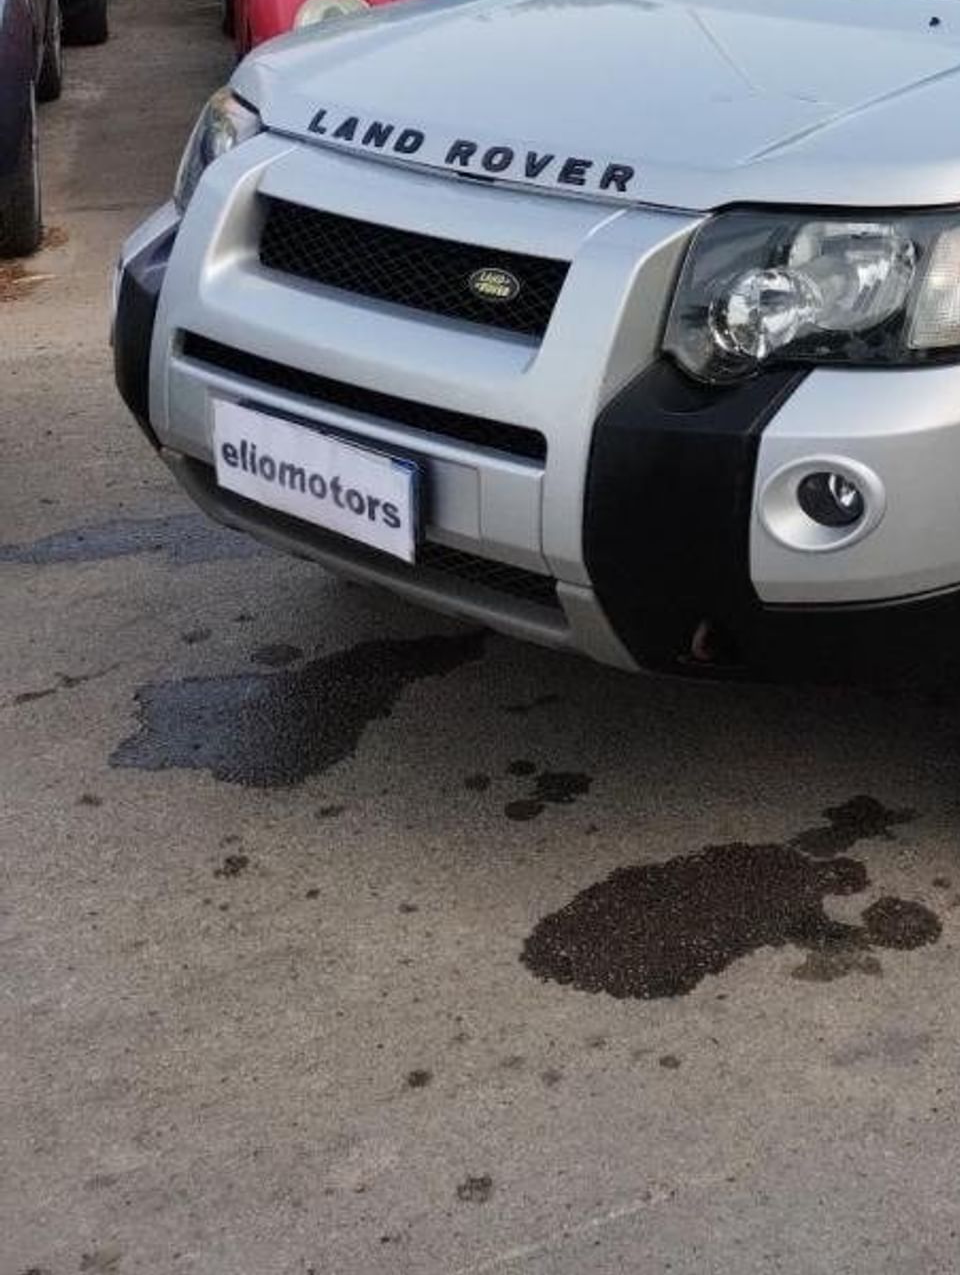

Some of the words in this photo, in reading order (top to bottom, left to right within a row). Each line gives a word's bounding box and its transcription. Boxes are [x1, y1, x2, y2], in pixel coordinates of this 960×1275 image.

[307, 109, 425, 154] LAND
[445, 139, 635, 192] ROVER
[221, 439, 402, 528] eliomotors
